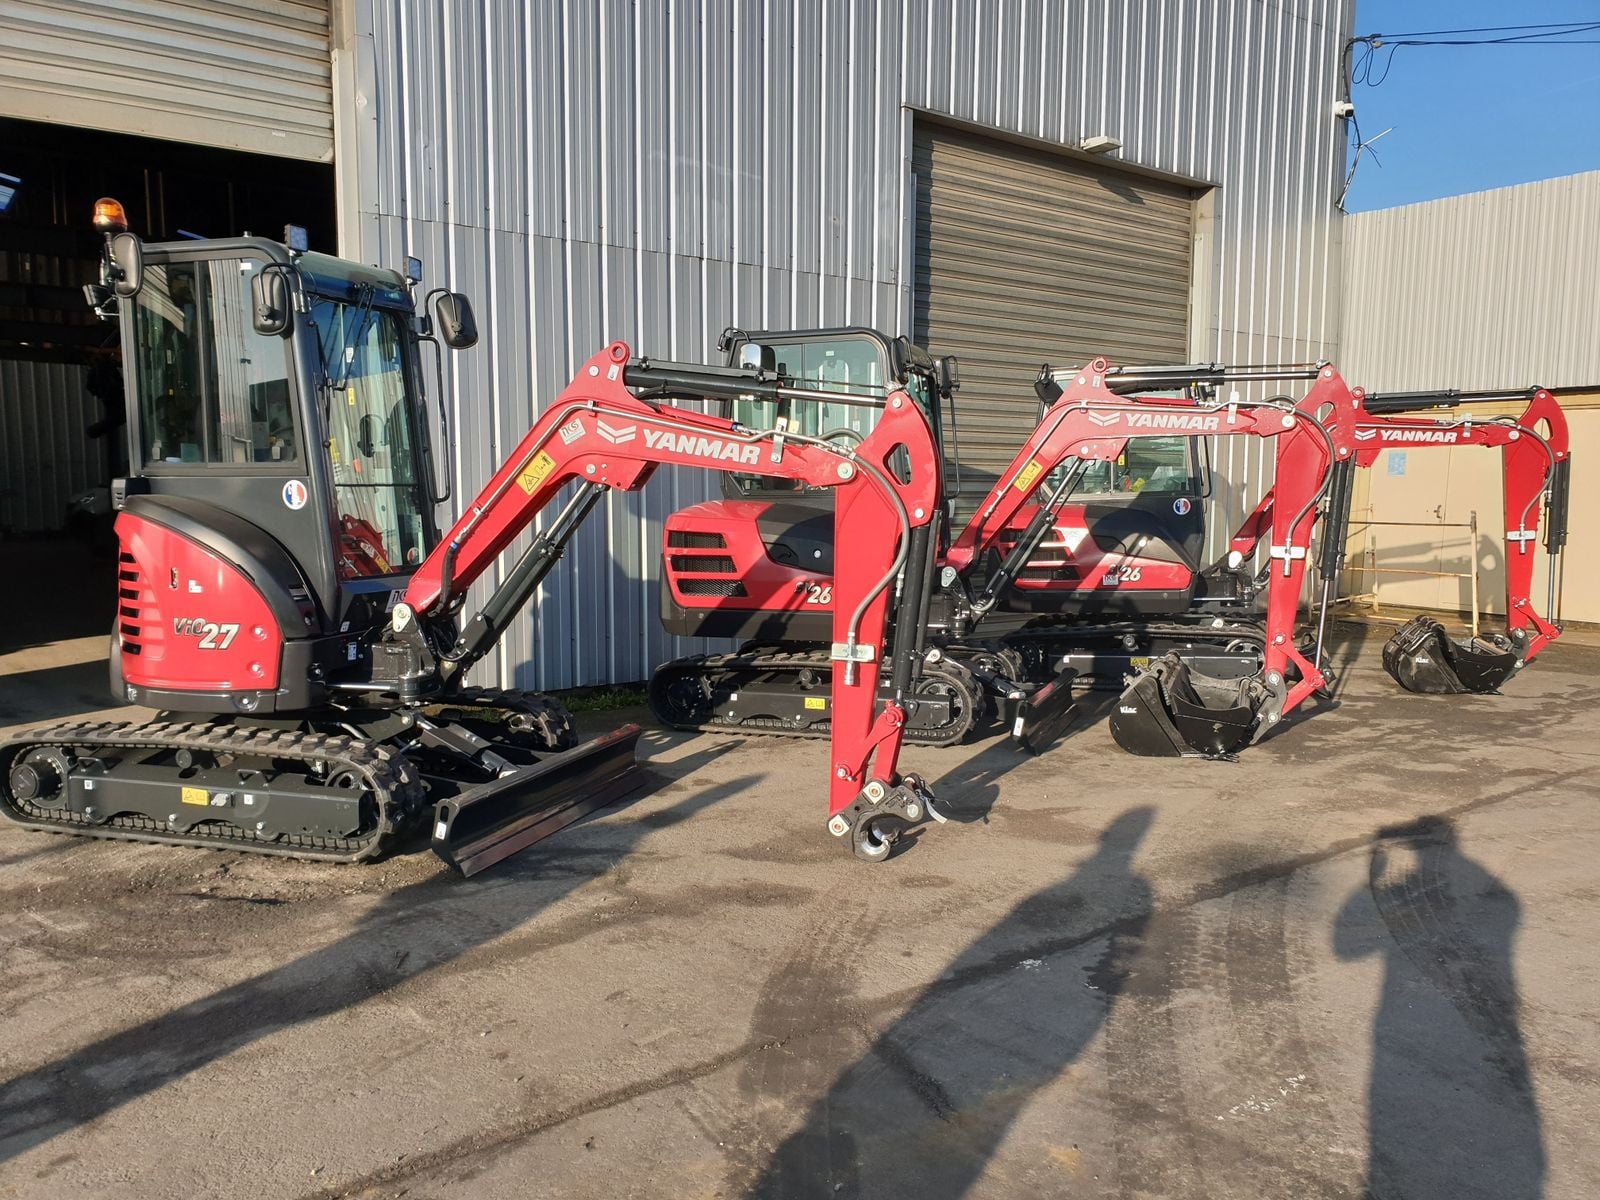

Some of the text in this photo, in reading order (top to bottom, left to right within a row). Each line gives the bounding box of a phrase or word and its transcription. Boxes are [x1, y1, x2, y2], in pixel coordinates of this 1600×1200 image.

[1124, 413, 1219, 430] YANMAR
[1380, 429, 1458, 443] YANMAR
[643, 428, 761, 465] YANMAR
